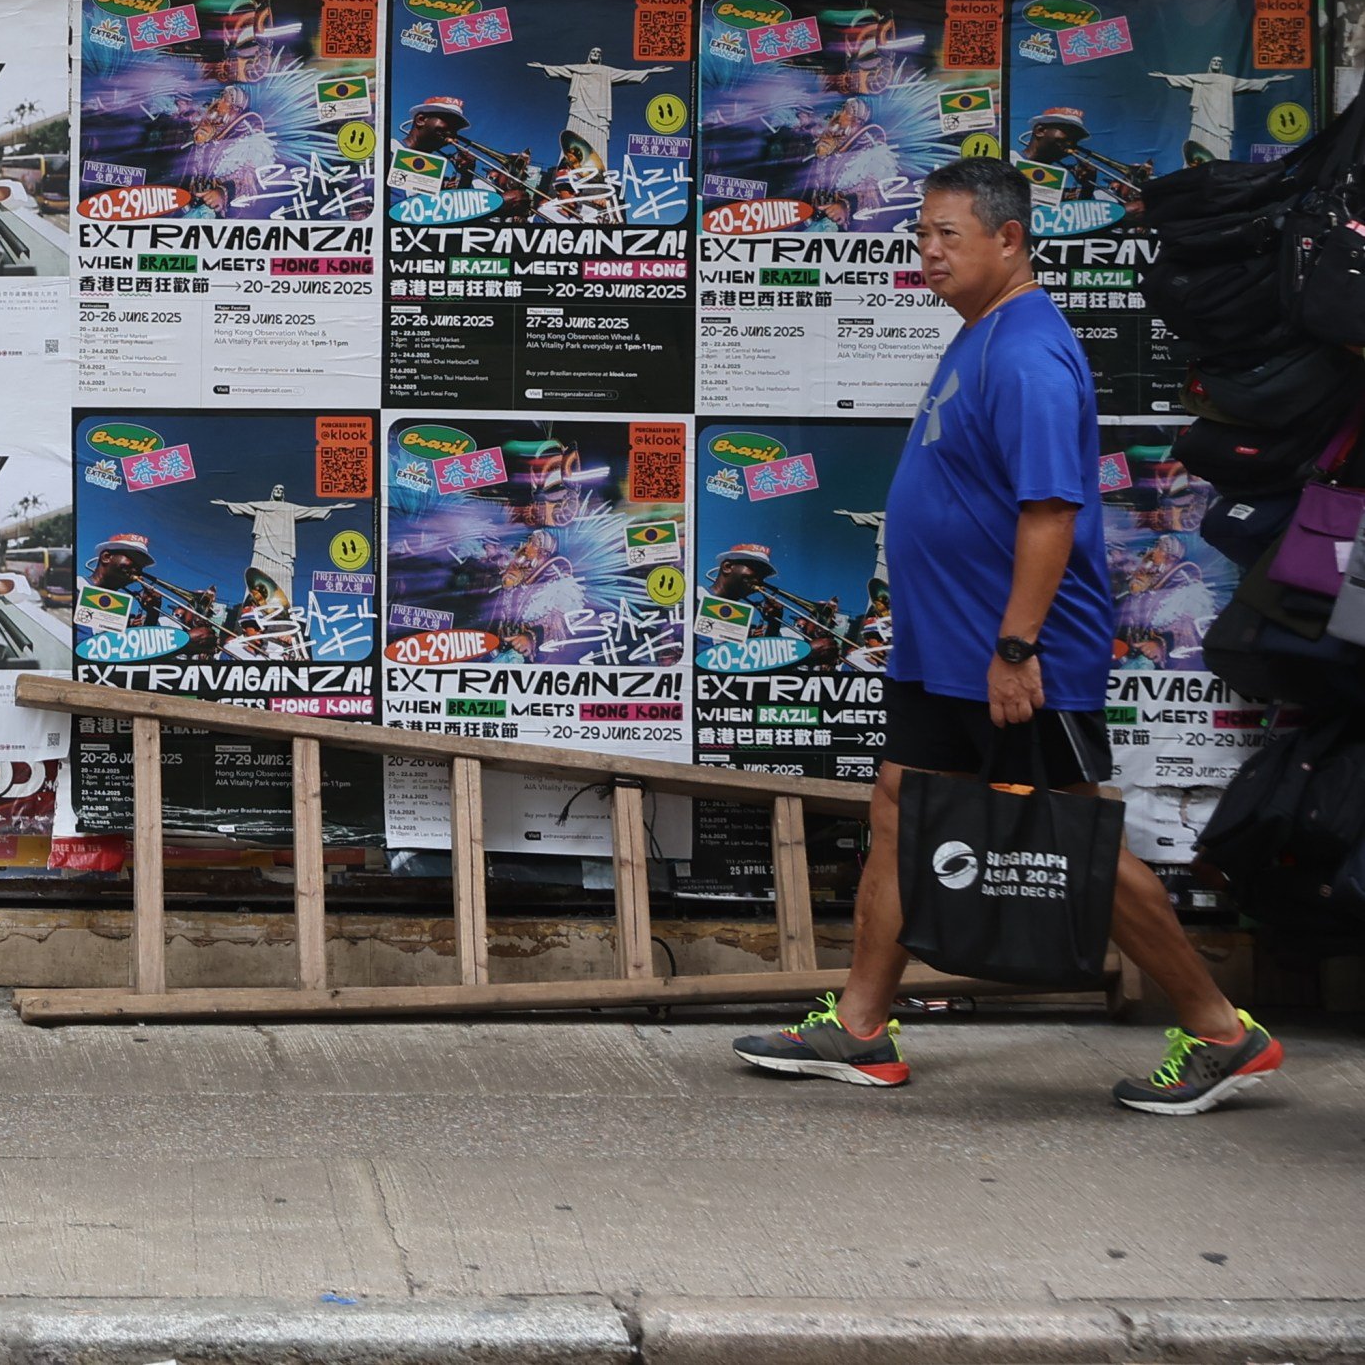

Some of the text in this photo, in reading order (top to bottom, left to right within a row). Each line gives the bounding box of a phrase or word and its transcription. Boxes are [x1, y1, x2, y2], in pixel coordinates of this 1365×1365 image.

[79, 223, 373, 255] EXTRAVAGANZA!
[390, 227, 686, 258] EXTRAVAGANZA!
[78, 255, 373, 275] WHEN BRAZIL MEETS HONG KONG
[78, 276, 209, 294] 香港巴西狂歡節
[243, 279, 290, 295] 20-29
[333, 281, 373, 296] 2025
[526, 316, 563, 329] 27-29
[598, 318, 630, 330] 2025
[541, 341, 565, 352] Vitality
[566, 341, 581, 351] Park
[624, 342, 663, 352] 1pm-11pm
[986, 850, 1069, 871] SIGGRAPH
[983, 867, 1020, 883] ASIA
[1020, 885, 1047, 899] DEC
